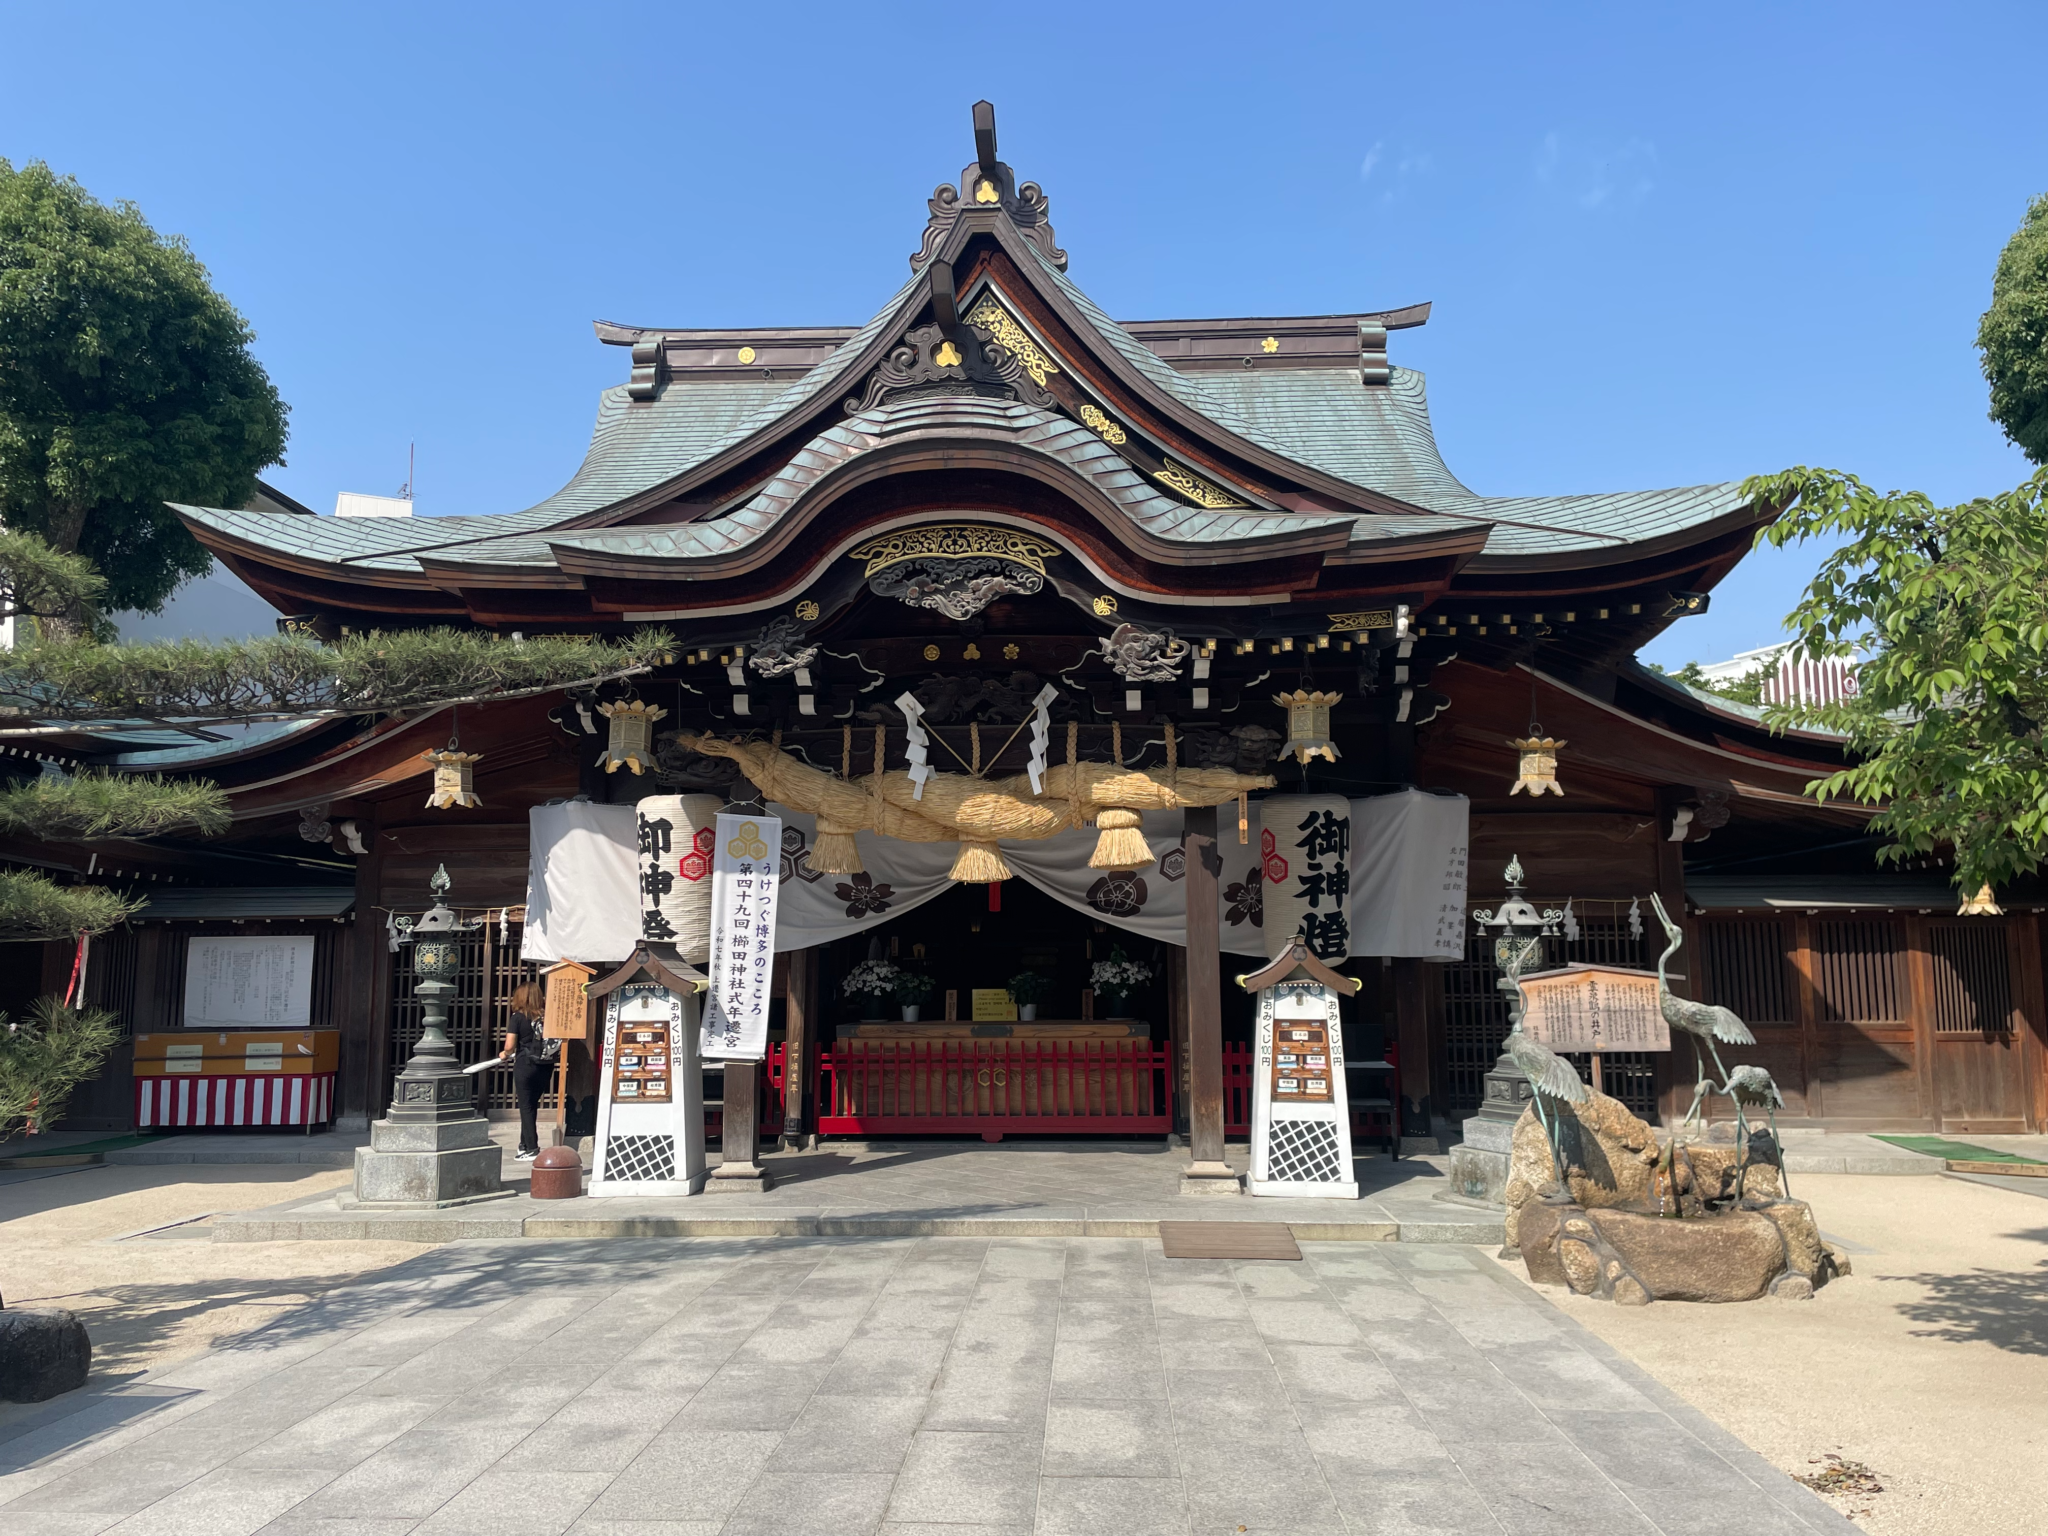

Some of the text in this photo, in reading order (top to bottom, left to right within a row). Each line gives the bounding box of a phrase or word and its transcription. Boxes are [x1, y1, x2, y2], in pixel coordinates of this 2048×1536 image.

[751, 863, 772, 1015] うけつぐ博多のこころ
[1293, 810, 1350, 960] 御神燈
